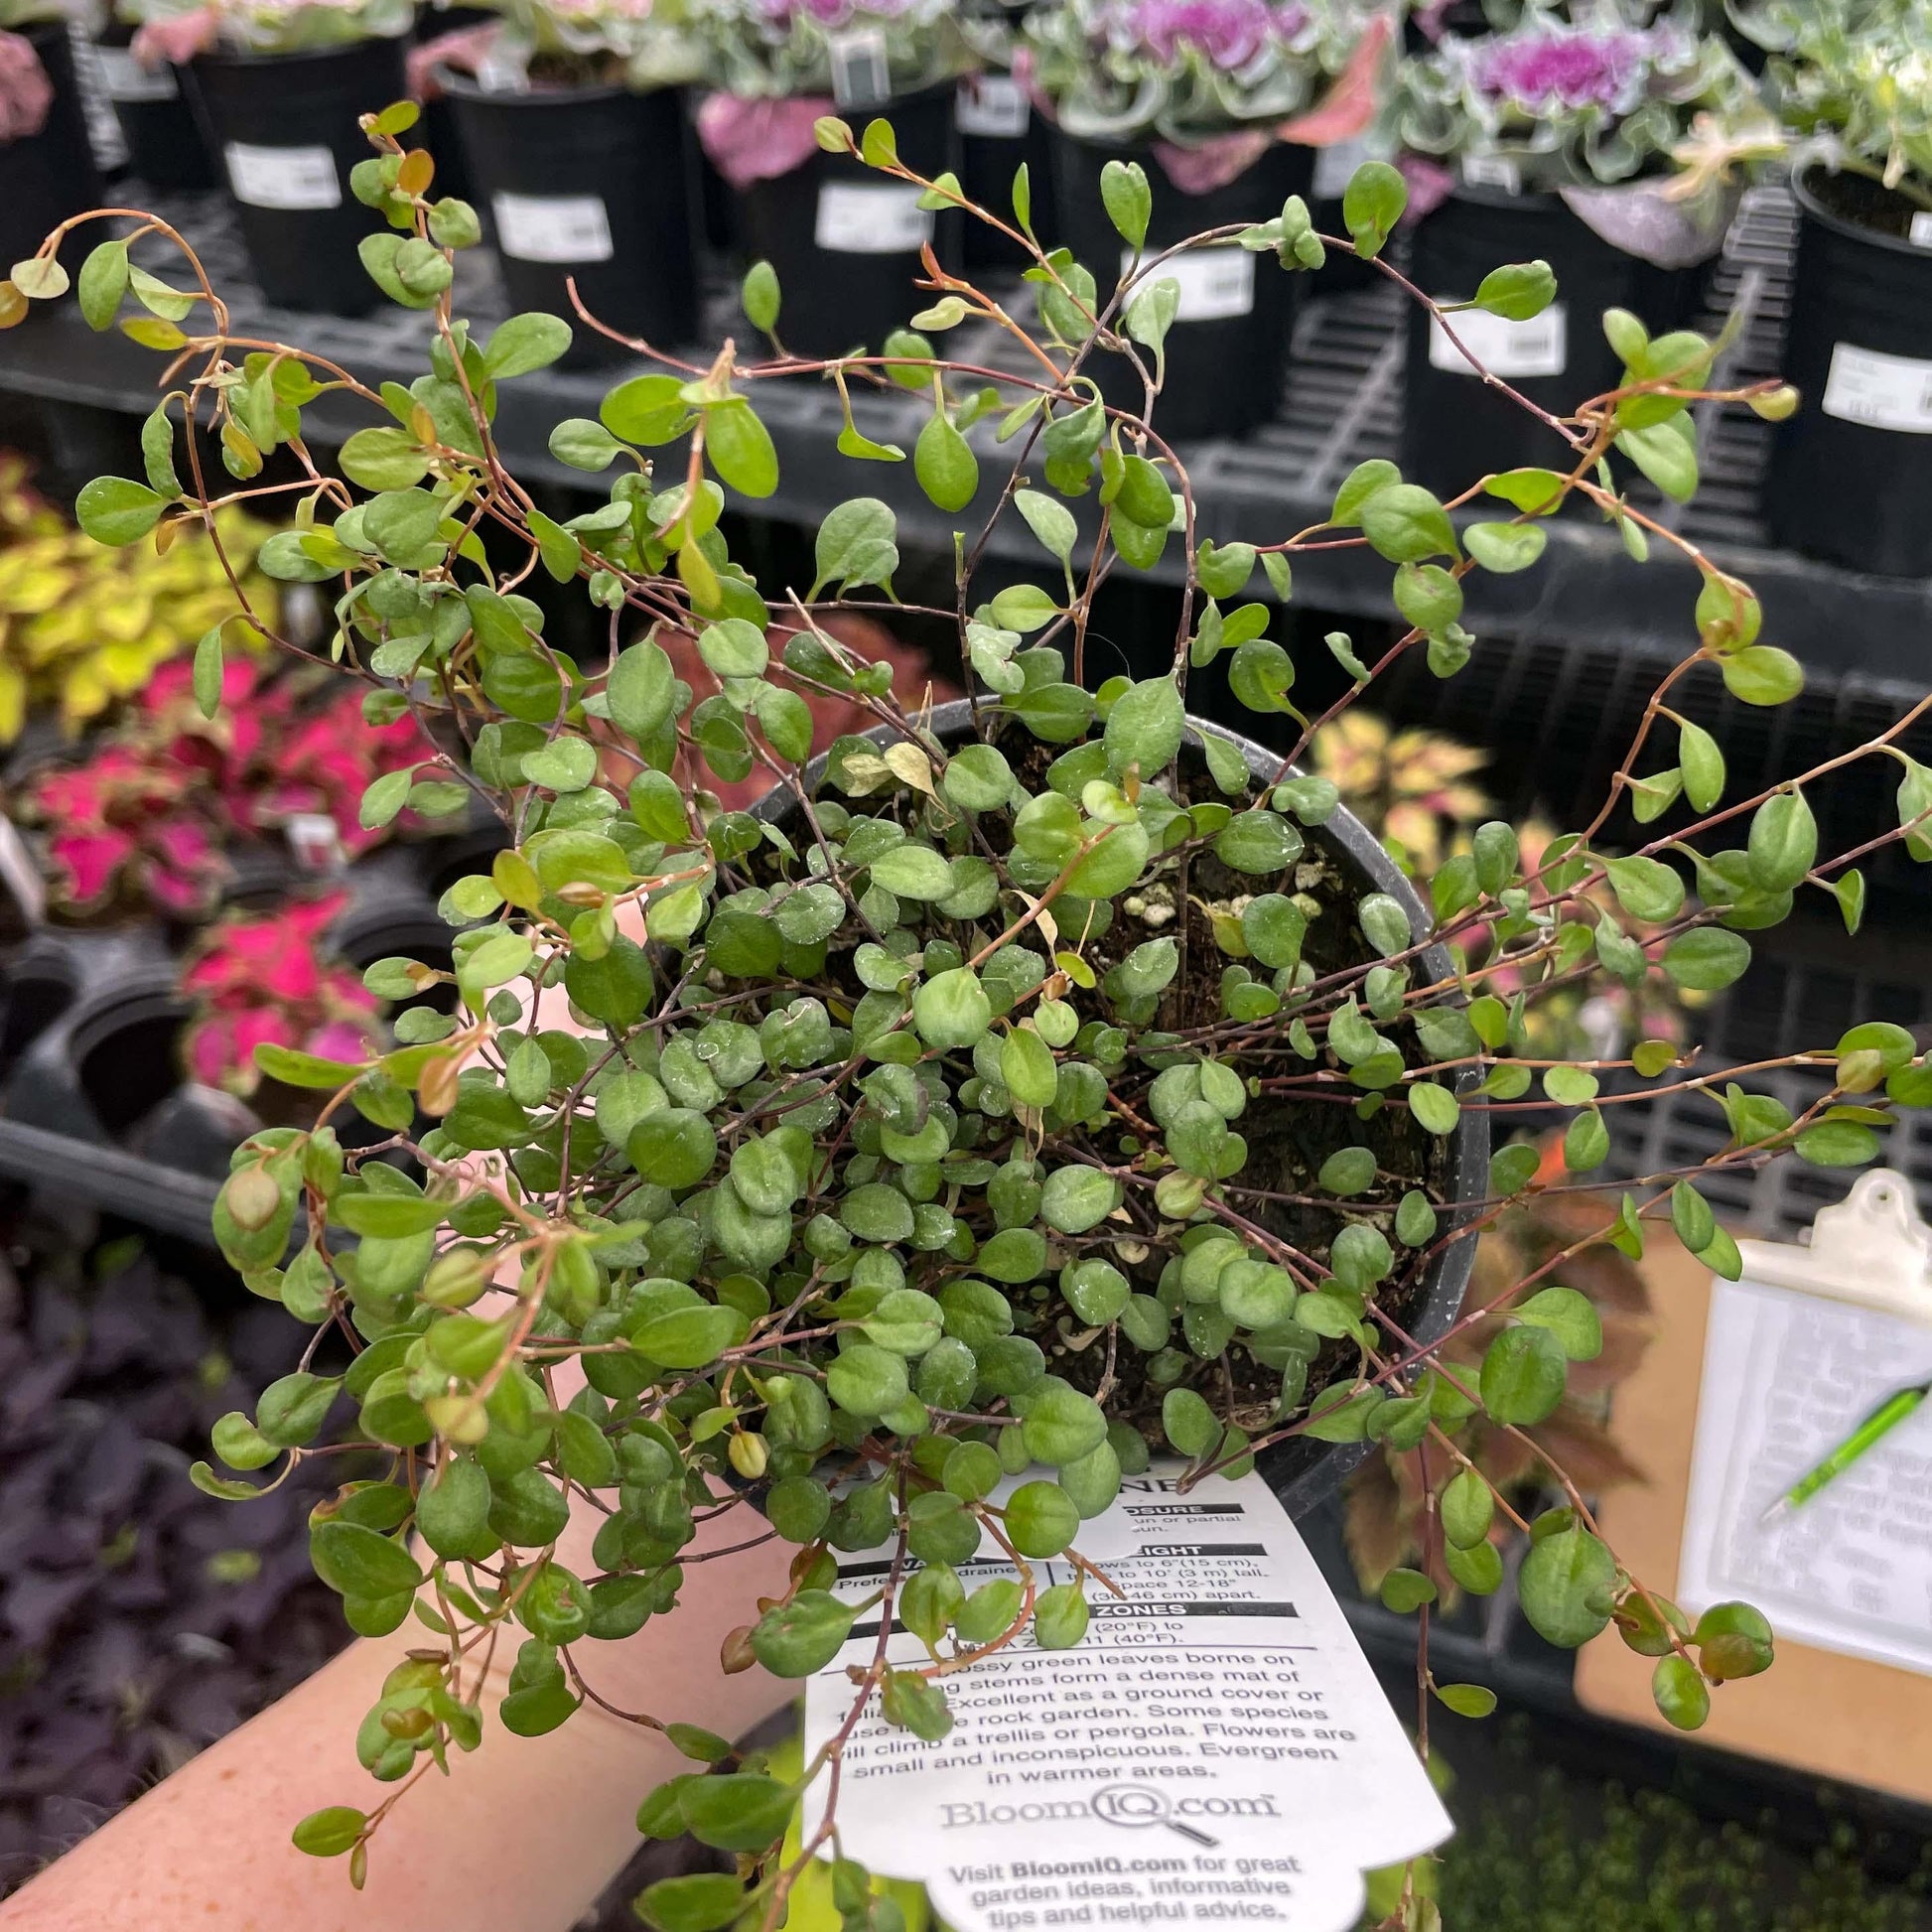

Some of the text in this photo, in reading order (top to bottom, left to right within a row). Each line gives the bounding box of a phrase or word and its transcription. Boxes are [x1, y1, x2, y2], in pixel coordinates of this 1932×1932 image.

[1186, 1515, 1242, 1525] partial
[1137, 1559, 1155, 1568] to
[1119, 1571, 1137, 1580] to
[1203, 1569, 1228, 1579] m)
[1234, 1569, 1270, 1578] tall.
[1162, 1589, 1197, 1600] cm)
[1205, 1590, 1262, 1601] apart.
[1095, 1603, 1187, 1616] ZONES
[1164, 1620, 1183, 1630] to
[1022, 1656, 1091, 1671] green
[1099, 1653, 1179, 1665] leaves
[1185, 1653, 1256, 1664] borne
[1264, 1655, 1296, 1665] on
[970, 1670, 1301, 1690] stems form a dense mat of
[946, 1691, 1056, 1710] Excellent
[1064, 1691, 1093, 1702] as
[1102, 1690, 1117, 1701] a
[1126, 1688, 1213, 1702] ground
[1221, 1689, 1289, 1700] cover
[1298, 1690, 1324, 1702] or
[978, 1712, 1033, 1725] rock
[1041, 1708, 1138, 1724] garden.
[1148, 1705, 1223, 1719] Some
[1231, 1707, 1330, 1721] species
[952, 1736, 968, 1747] a
[977, 1728, 1045, 1744] trellis
[1054, 1728, 1080, 1739] or
[1089, 1723, 1195, 1740] pergola.
[1203, 1723, 1307, 1739] Flowers
[1313, 1727, 1357, 1740] are
[854, 1742, 1339, 1779] small and inconspicuous. Evergreen
[987, 1765, 1217, 1785] in warmer areas.
[949, 1854, 1303, 1883] Visit BloomIQ.com for great
[971, 1874, 1293, 1908] garden ideas, informative
[988, 1898, 1288, 1930] tips and helpful advice.
